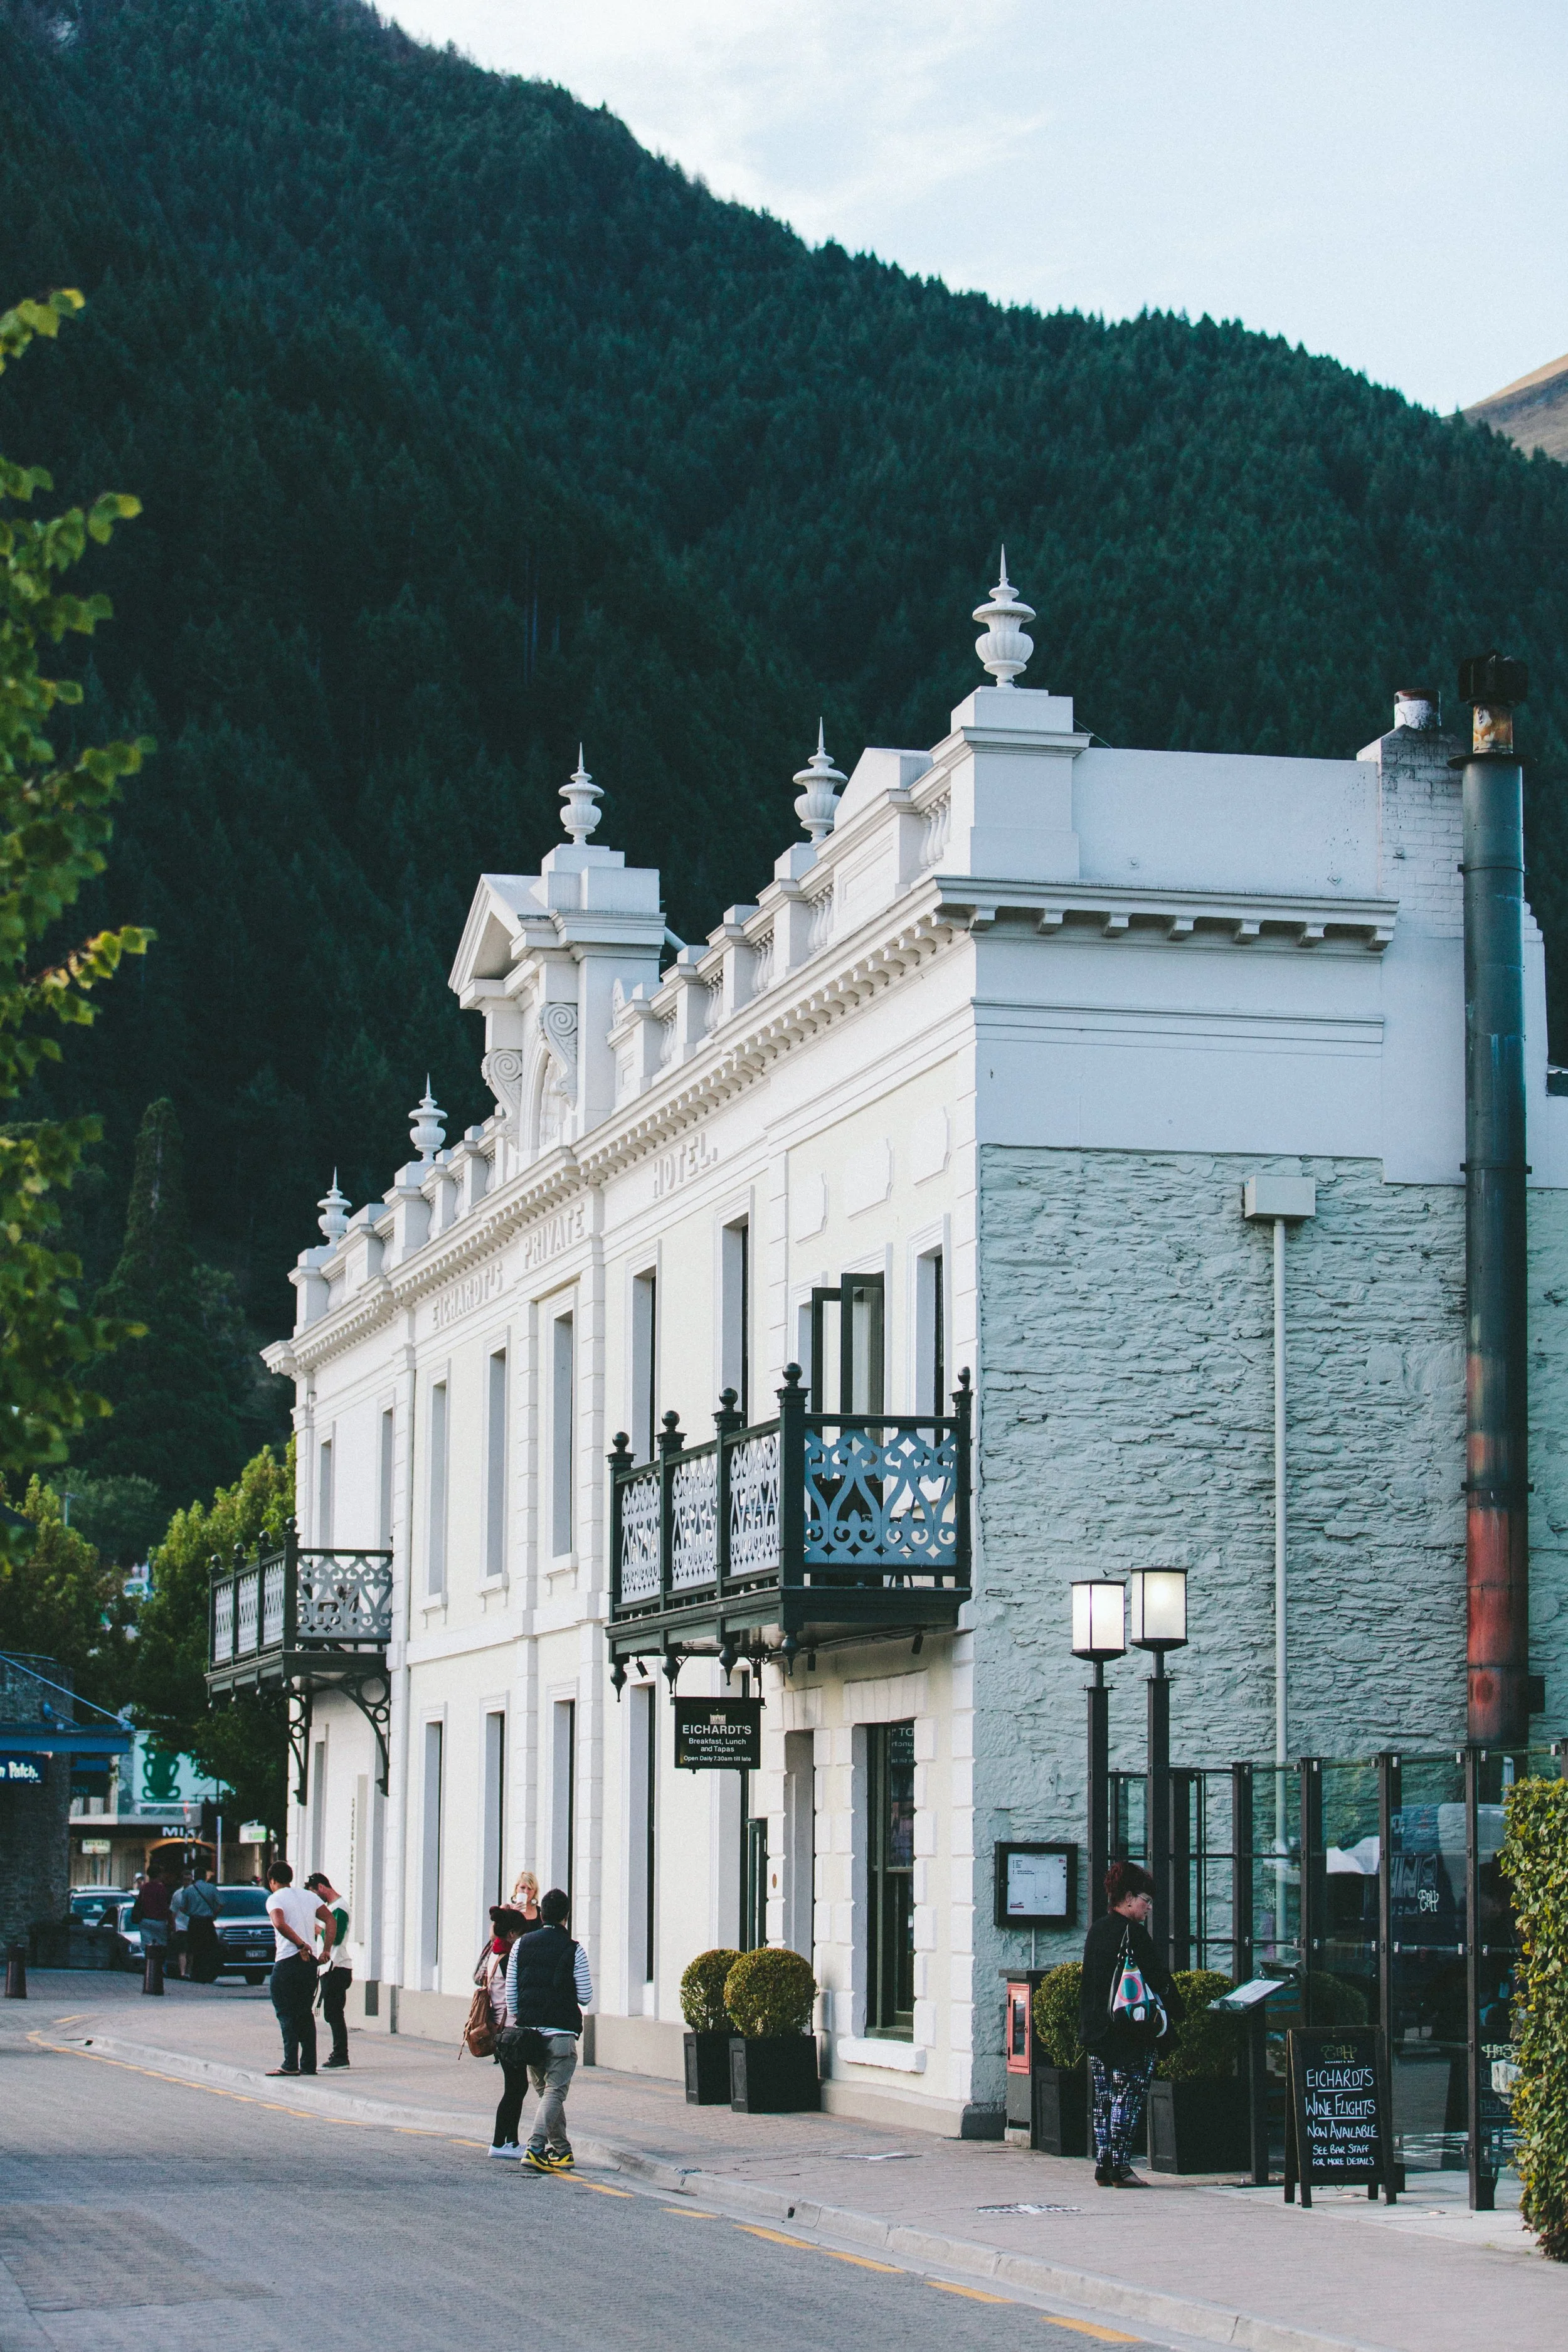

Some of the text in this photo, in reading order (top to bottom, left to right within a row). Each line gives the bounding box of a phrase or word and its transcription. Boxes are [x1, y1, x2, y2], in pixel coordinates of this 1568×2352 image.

[523, 1202, 585, 1269] PRIVATE
[682, 1725, 751, 1735] EICHARDT'S
[1305, 2092, 1375, 2116] WINE FLIGHTS
[1307, 2120, 1379, 2140] NOW AVAILABLE
[1313, 2144, 1370, 2156] SEE BAR STAFF
[1312, 2157, 1374, 2166] FOR MORE DETAILS
